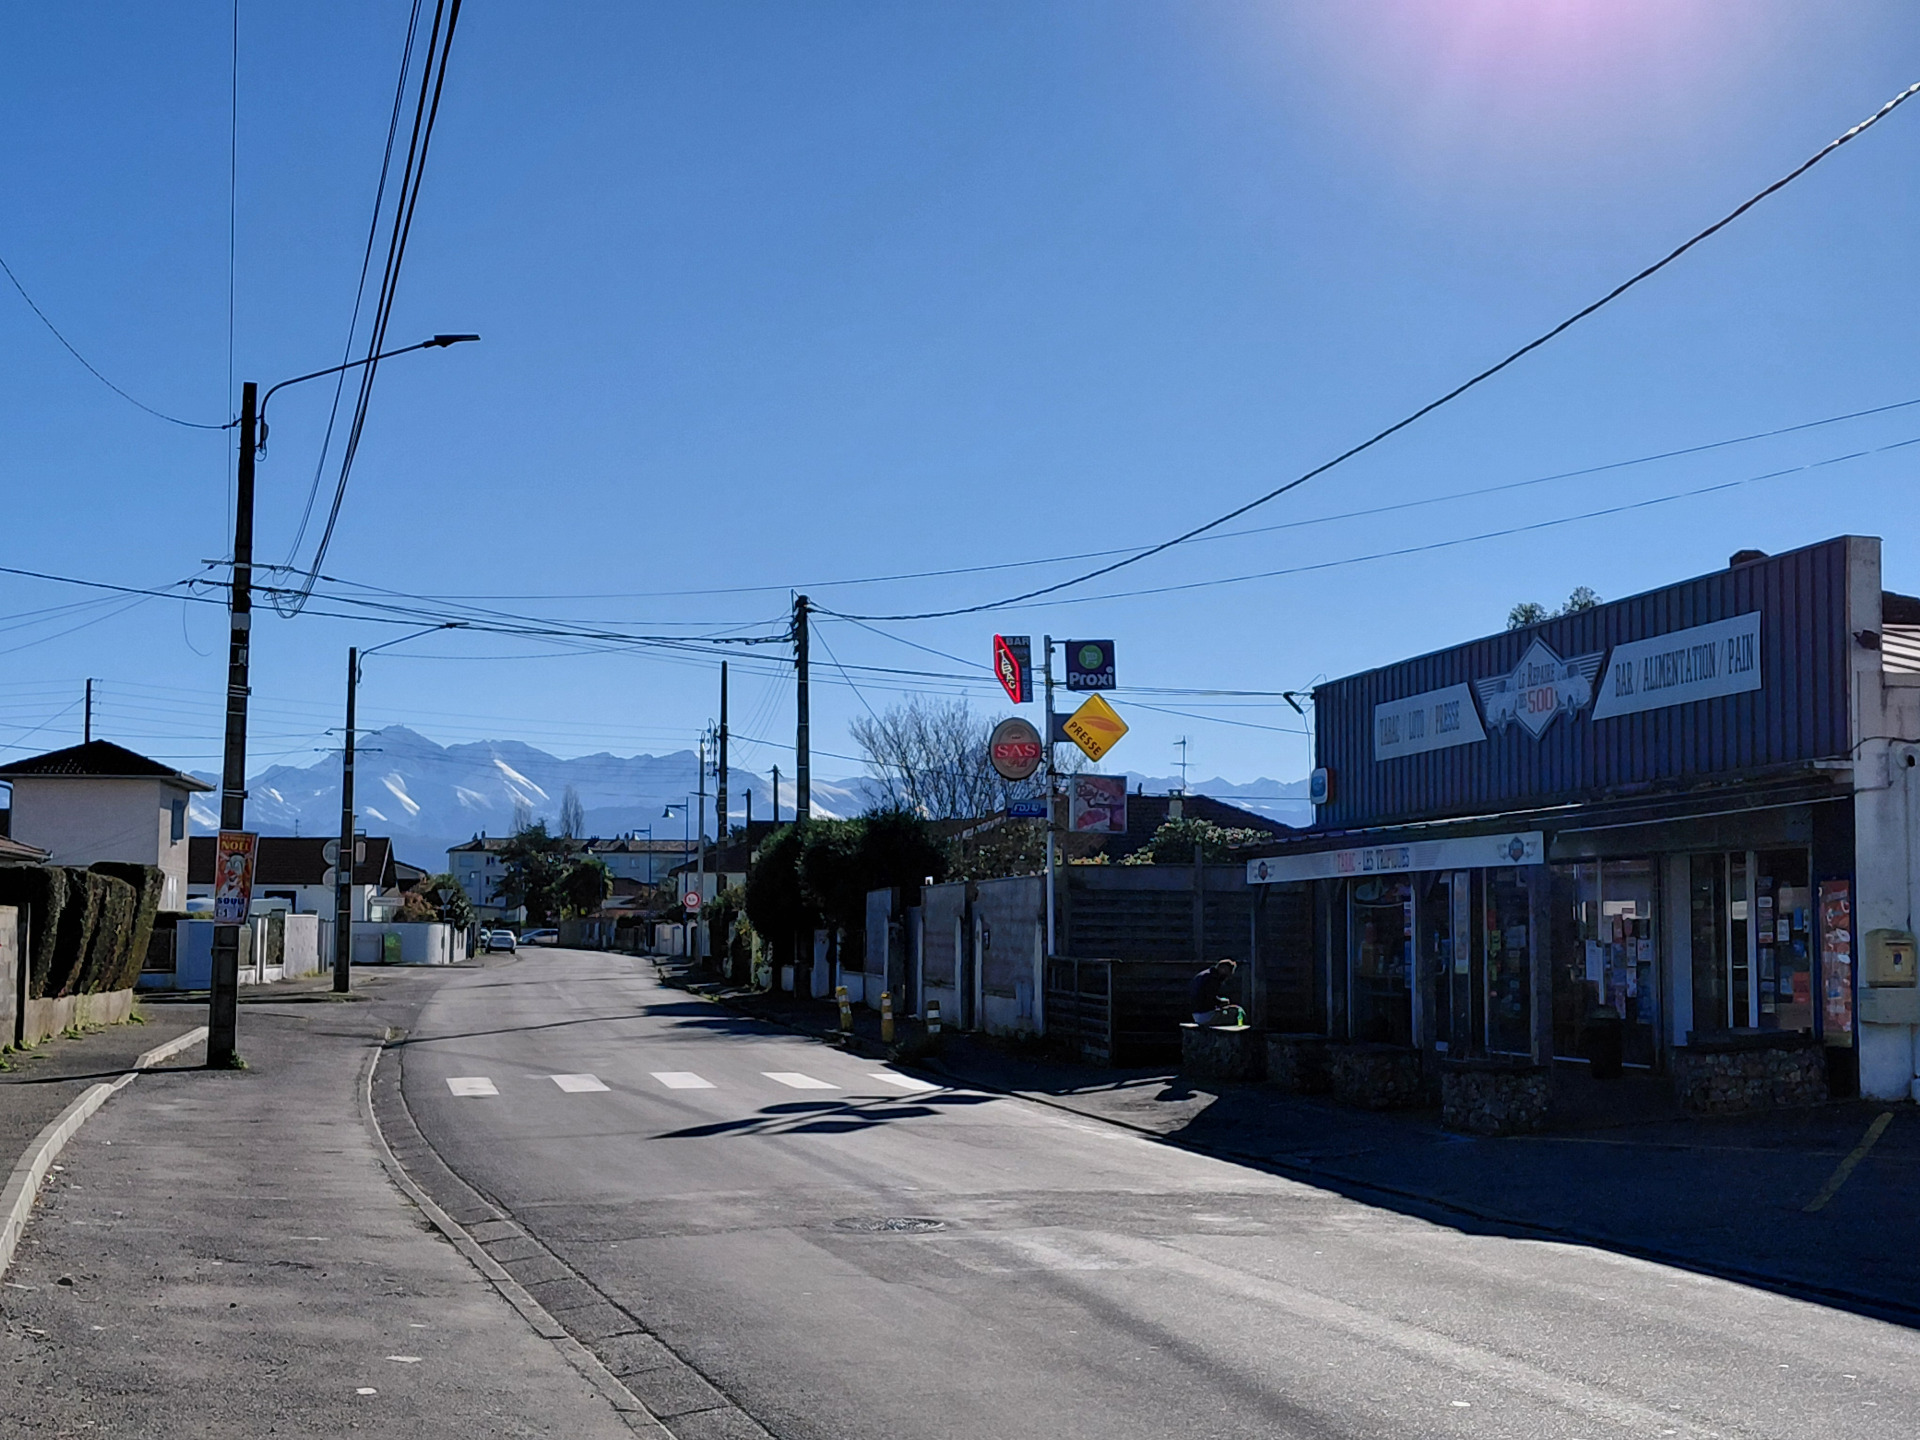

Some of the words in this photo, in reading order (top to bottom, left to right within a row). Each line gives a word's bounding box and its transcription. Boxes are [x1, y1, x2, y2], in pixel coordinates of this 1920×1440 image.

[1006, 637, 1030, 646] BAR
[998, 648, 1016, 690] TABAC
[1069, 666, 1113, 686] Proxi
[1615, 661, 1634, 698] BAR
[1643, 641, 1716, 692] ALIMENTATION
[1727, 633, 1754, 675] PAIN
[1528, 687, 1553, 713] 500
[997, 743, 1037, 758] SAS
[1068, 721, 1102, 757] PRESSE
